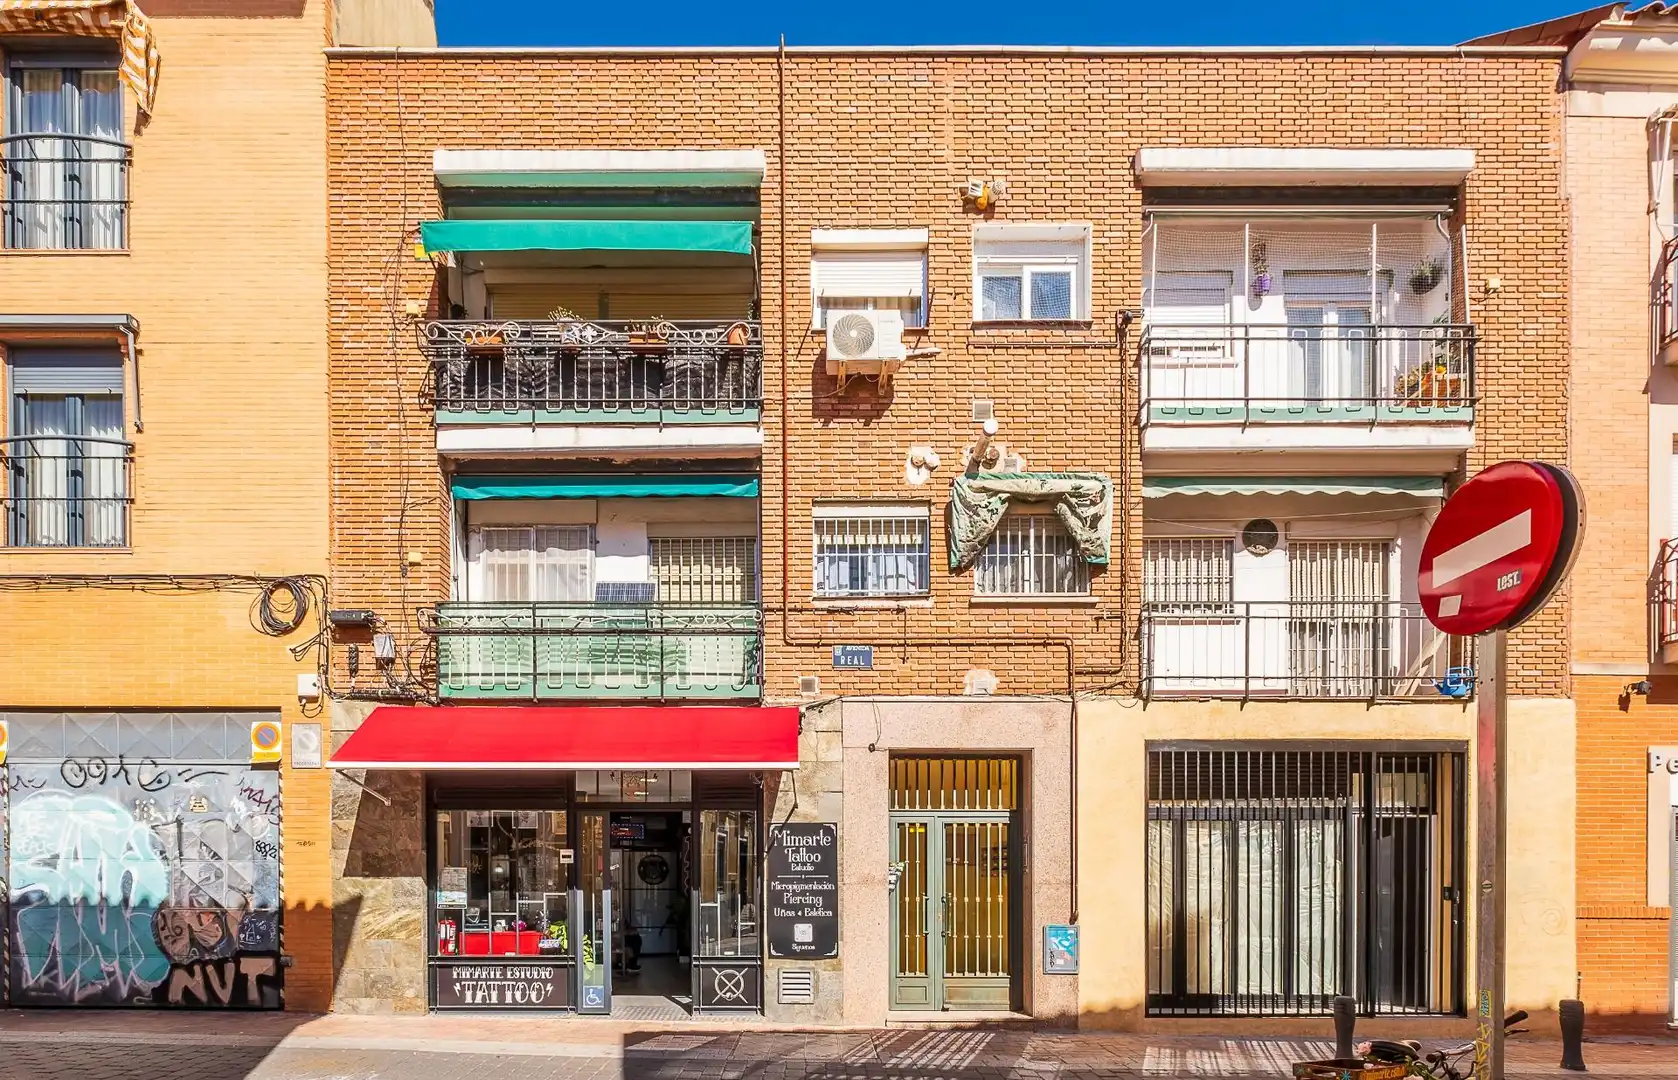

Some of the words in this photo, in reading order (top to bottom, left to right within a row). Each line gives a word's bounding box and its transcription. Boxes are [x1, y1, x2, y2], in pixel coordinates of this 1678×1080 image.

[840, 655, 865, 666] REAL
[774, 829, 831, 847] Mimarte
[784, 847, 821, 863] Tattoo
[791, 863, 815, 871] Estudio
[783, 892, 823, 907] Piercing
[452, 966, 504, 979] MIMARTE
[506, 966, 554, 979] ESTUDIO
[461, 981, 545, 1004] TATTOO
